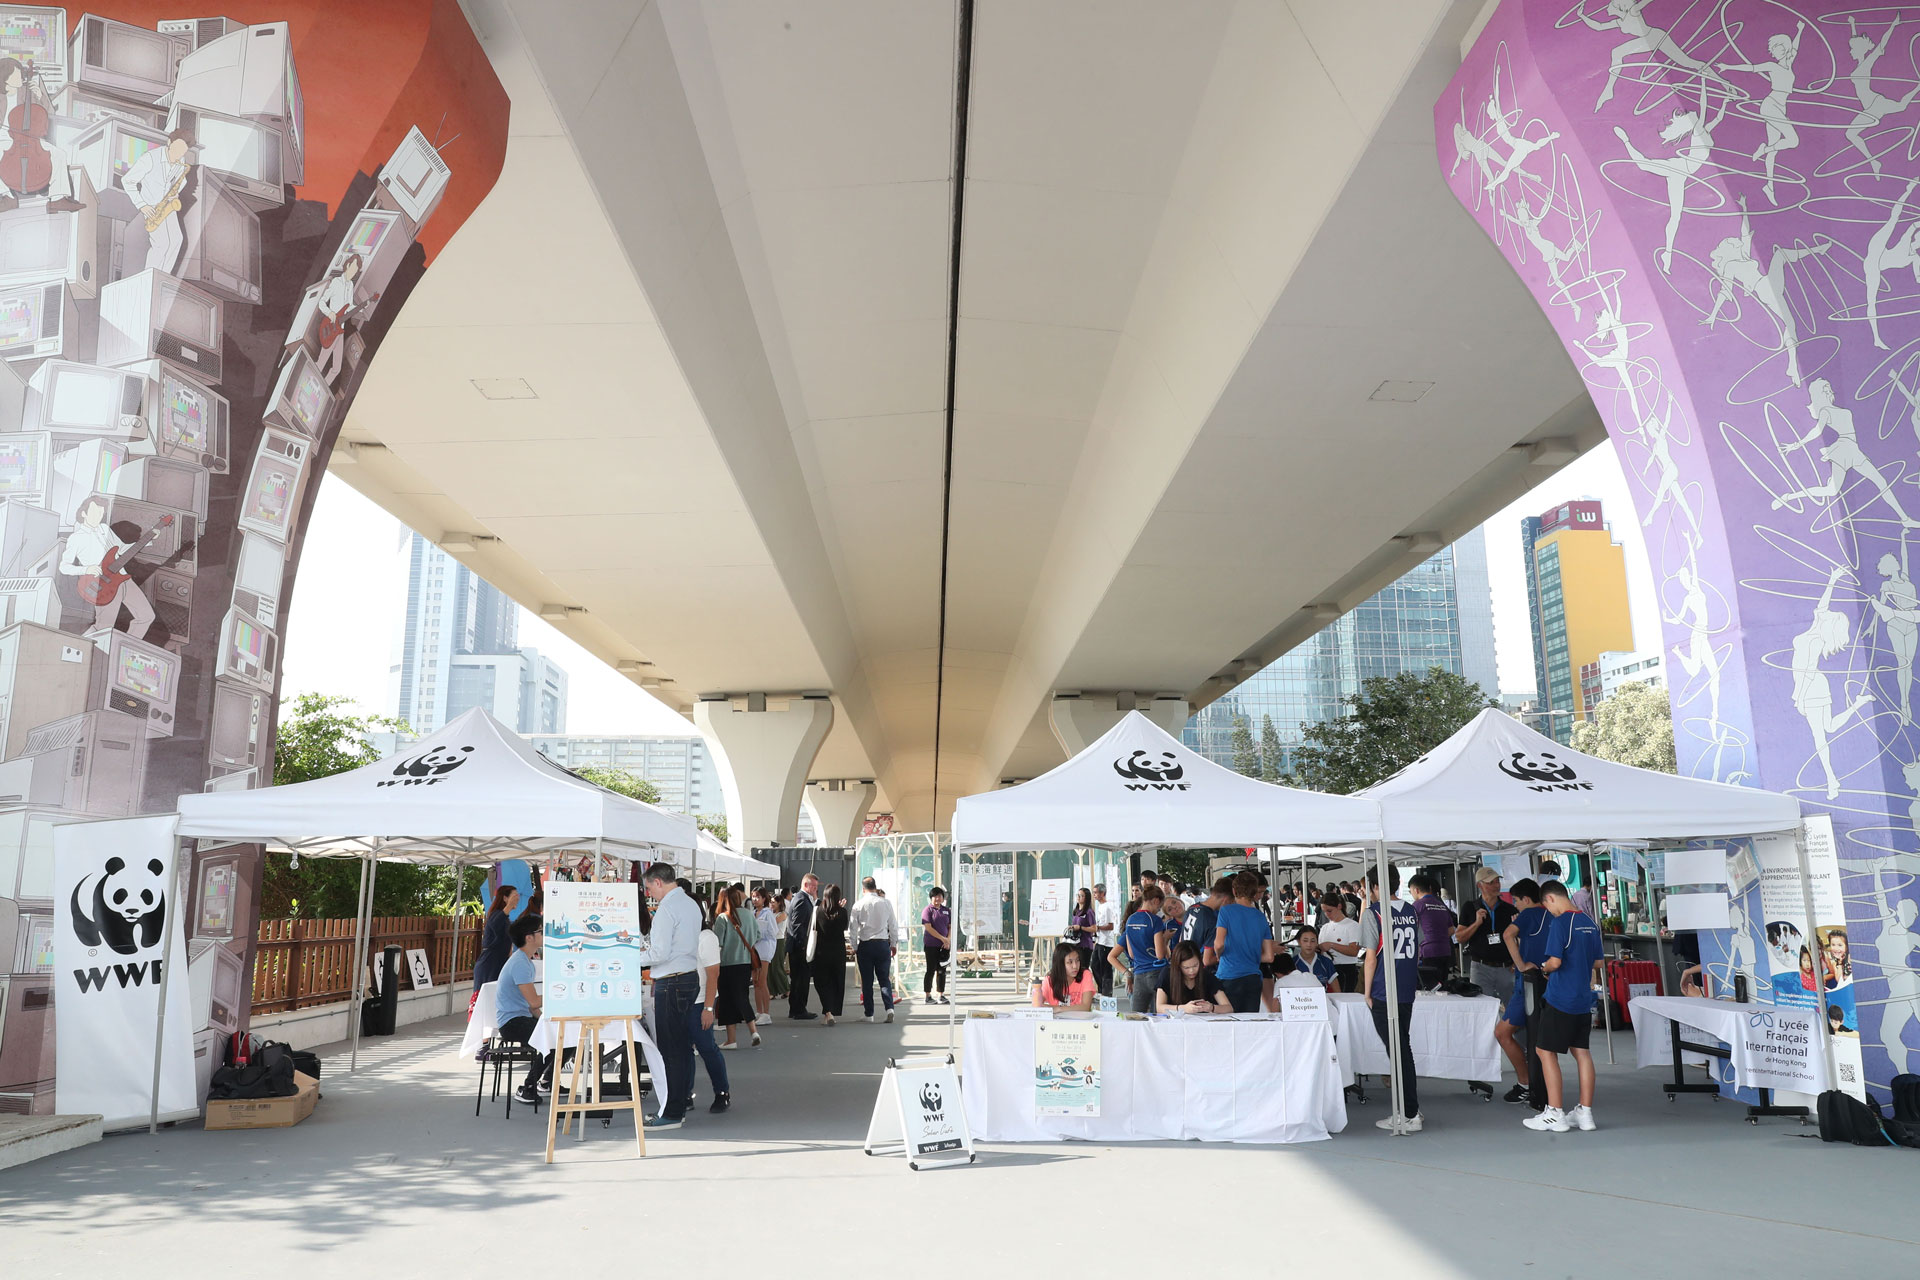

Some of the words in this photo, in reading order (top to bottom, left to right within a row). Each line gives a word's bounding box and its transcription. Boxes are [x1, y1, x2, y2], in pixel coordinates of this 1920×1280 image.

[377, 777, 448, 787] WWF
[1124, 783, 1192, 791] WWF
[1526, 782, 1594, 792] WWF
[1393, 926, 1415, 959] 23
[73, 959, 163, 994] WWF
[1778, 1018, 1809, 1031] Lycée
[1766, 1030, 1808, 1045] Français
[1772, 1056, 1790, 1066] Hong
[1790, 1059, 1807, 1068] Kong
[1792, 1071, 1815, 1081] School
[923, 1113, 945, 1123] WWF
[923, 1144, 940, 1153] WWF
